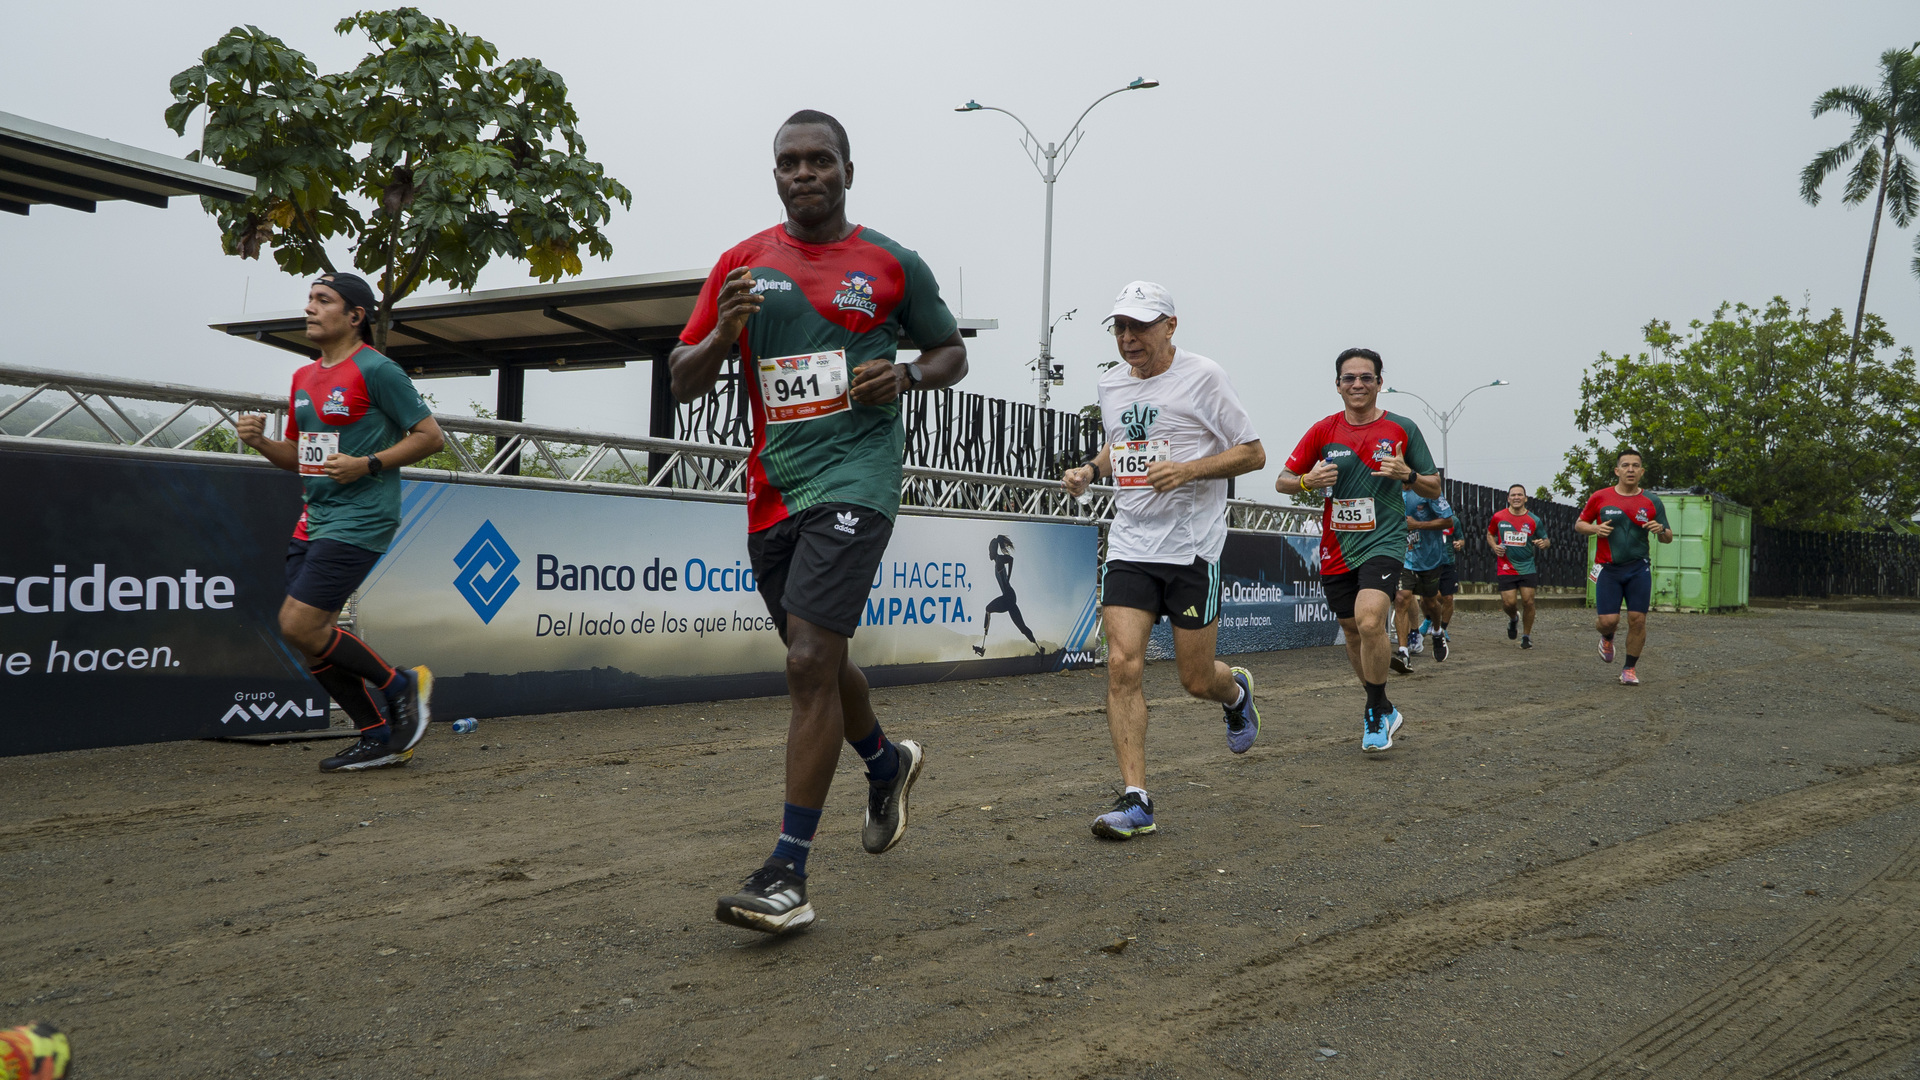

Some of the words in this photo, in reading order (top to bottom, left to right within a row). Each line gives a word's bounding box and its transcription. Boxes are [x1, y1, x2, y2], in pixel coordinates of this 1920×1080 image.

[832, 294, 877, 312] Muñeca
[774, 373, 820, 402] 941
[1337, 509, 1362, 521] 435
[834, 524, 856, 535] adidas
[536, 554, 636, 591] Banco
[643, 557, 678, 592] de
[684, 558, 757, 592] Occid
[871, 561, 883, 589] U
[893, 562, 972, 592] HACER,
[1232, 581, 1282, 602] Occidente
[1293, 581, 1306, 599] TU
[1223, 613, 1235, 627] los
[1235, 617, 1249, 630] que
[1250, 612, 1272, 626] hacen.
[1294, 603, 1338, 623] IMPAC
[536, 612, 573, 637] Del
[579, 612, 626, 636] lado
[631, 611, 655, 634] de
[661, 610, 688, 633] los
[694, 616, 727, 638] que
[732, 610, 777, 631] hace
[0, 652, 32, 675] e
[46, 640, 181, 673] hacen.
[234, 691, 276, 702] Grupo
